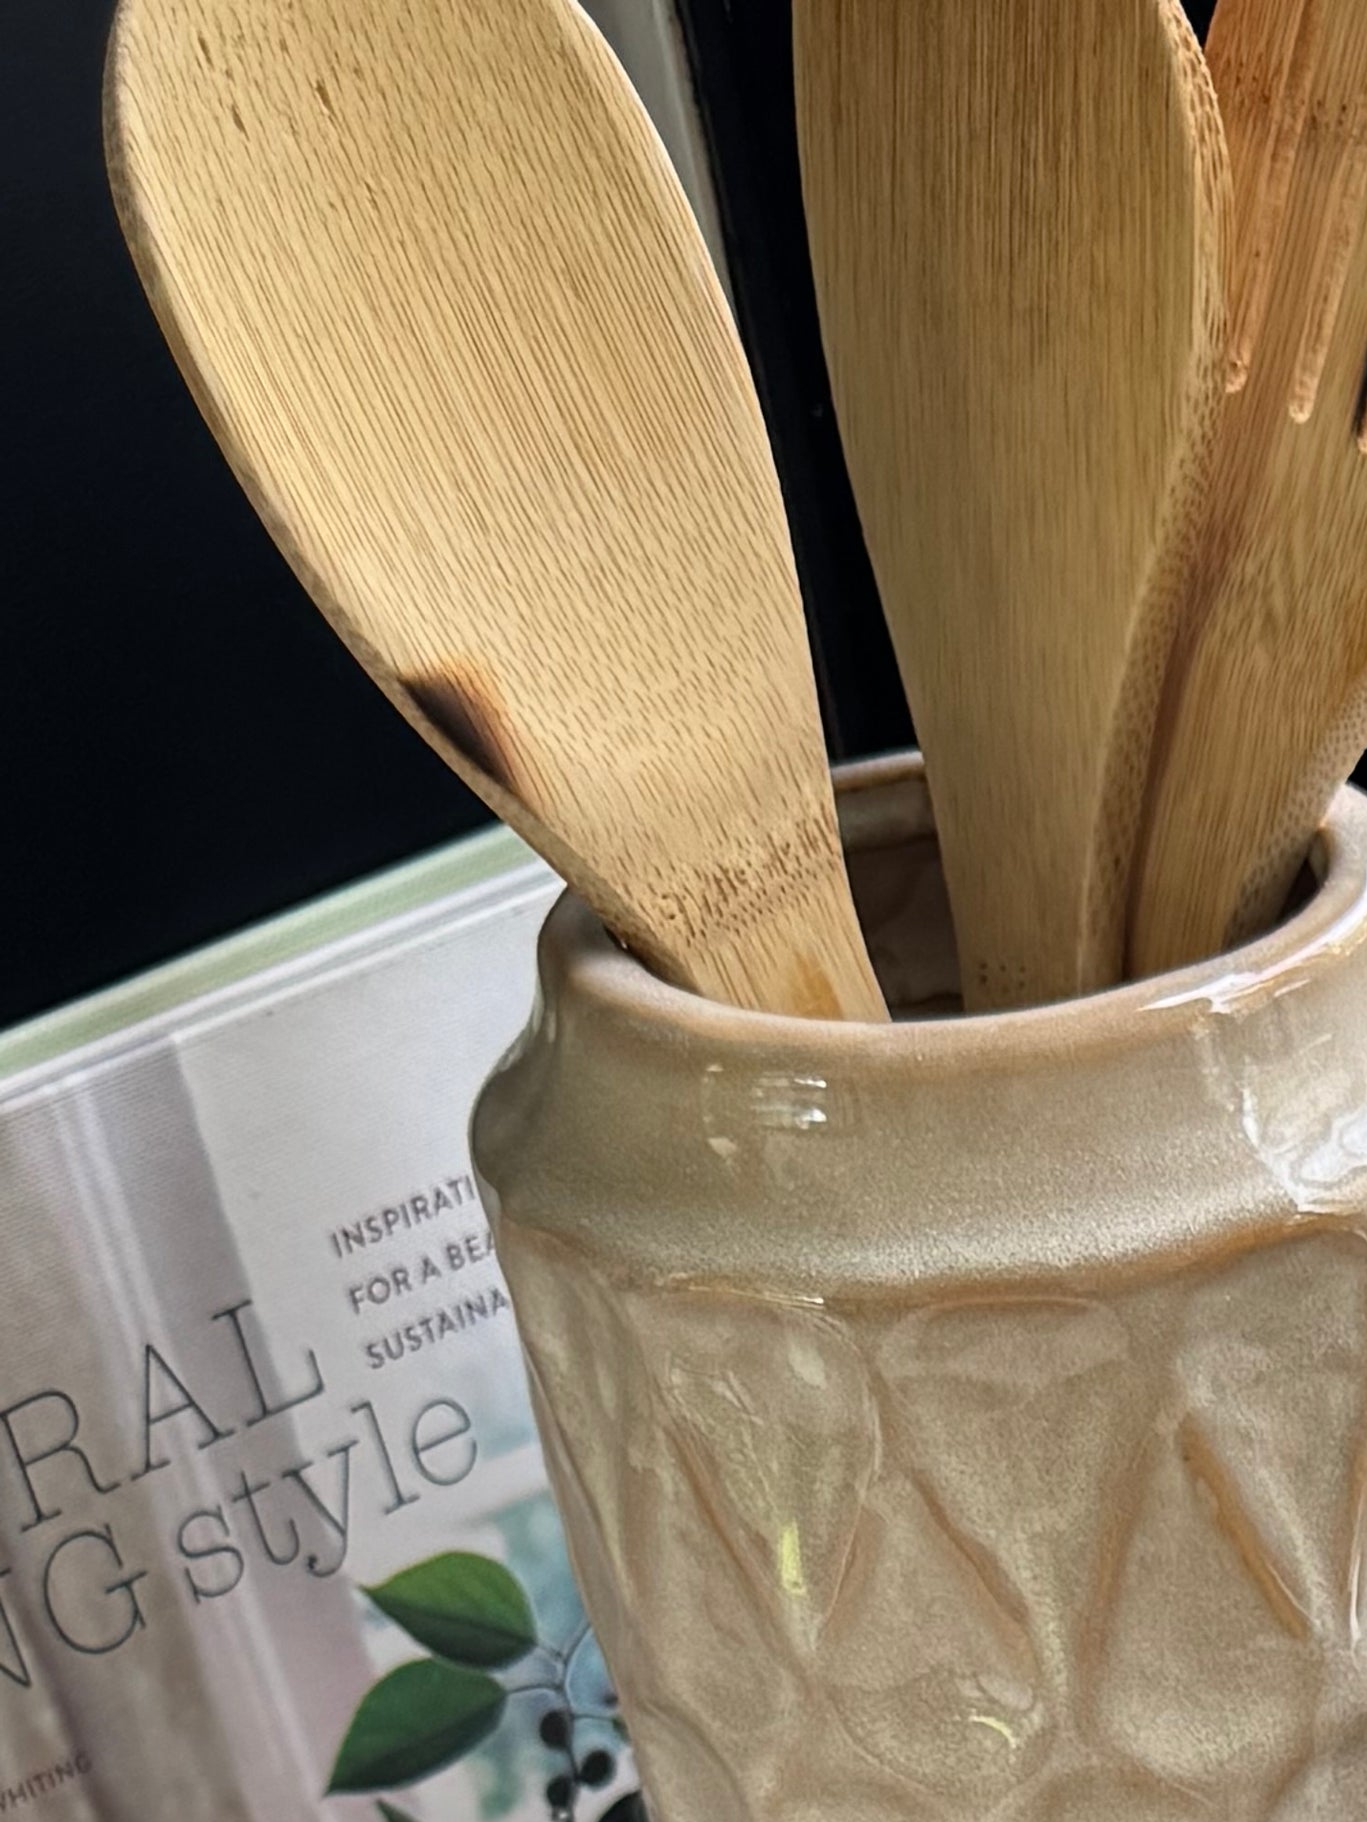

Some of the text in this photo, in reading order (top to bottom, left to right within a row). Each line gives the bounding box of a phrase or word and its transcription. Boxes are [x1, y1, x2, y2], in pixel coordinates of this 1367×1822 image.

[330, 1174, 476, 1258] INSPIRATI
[349, 1267, 413, 1315] FOR
[420, 1256, 442, 1283] A
[366, 1287, 509, 1370] SUSTAINA
[0, 1300, 326, 1533] RAL
[177, 1397, 479, 1605] style
[0, 1750, 93, 1812] HITING
